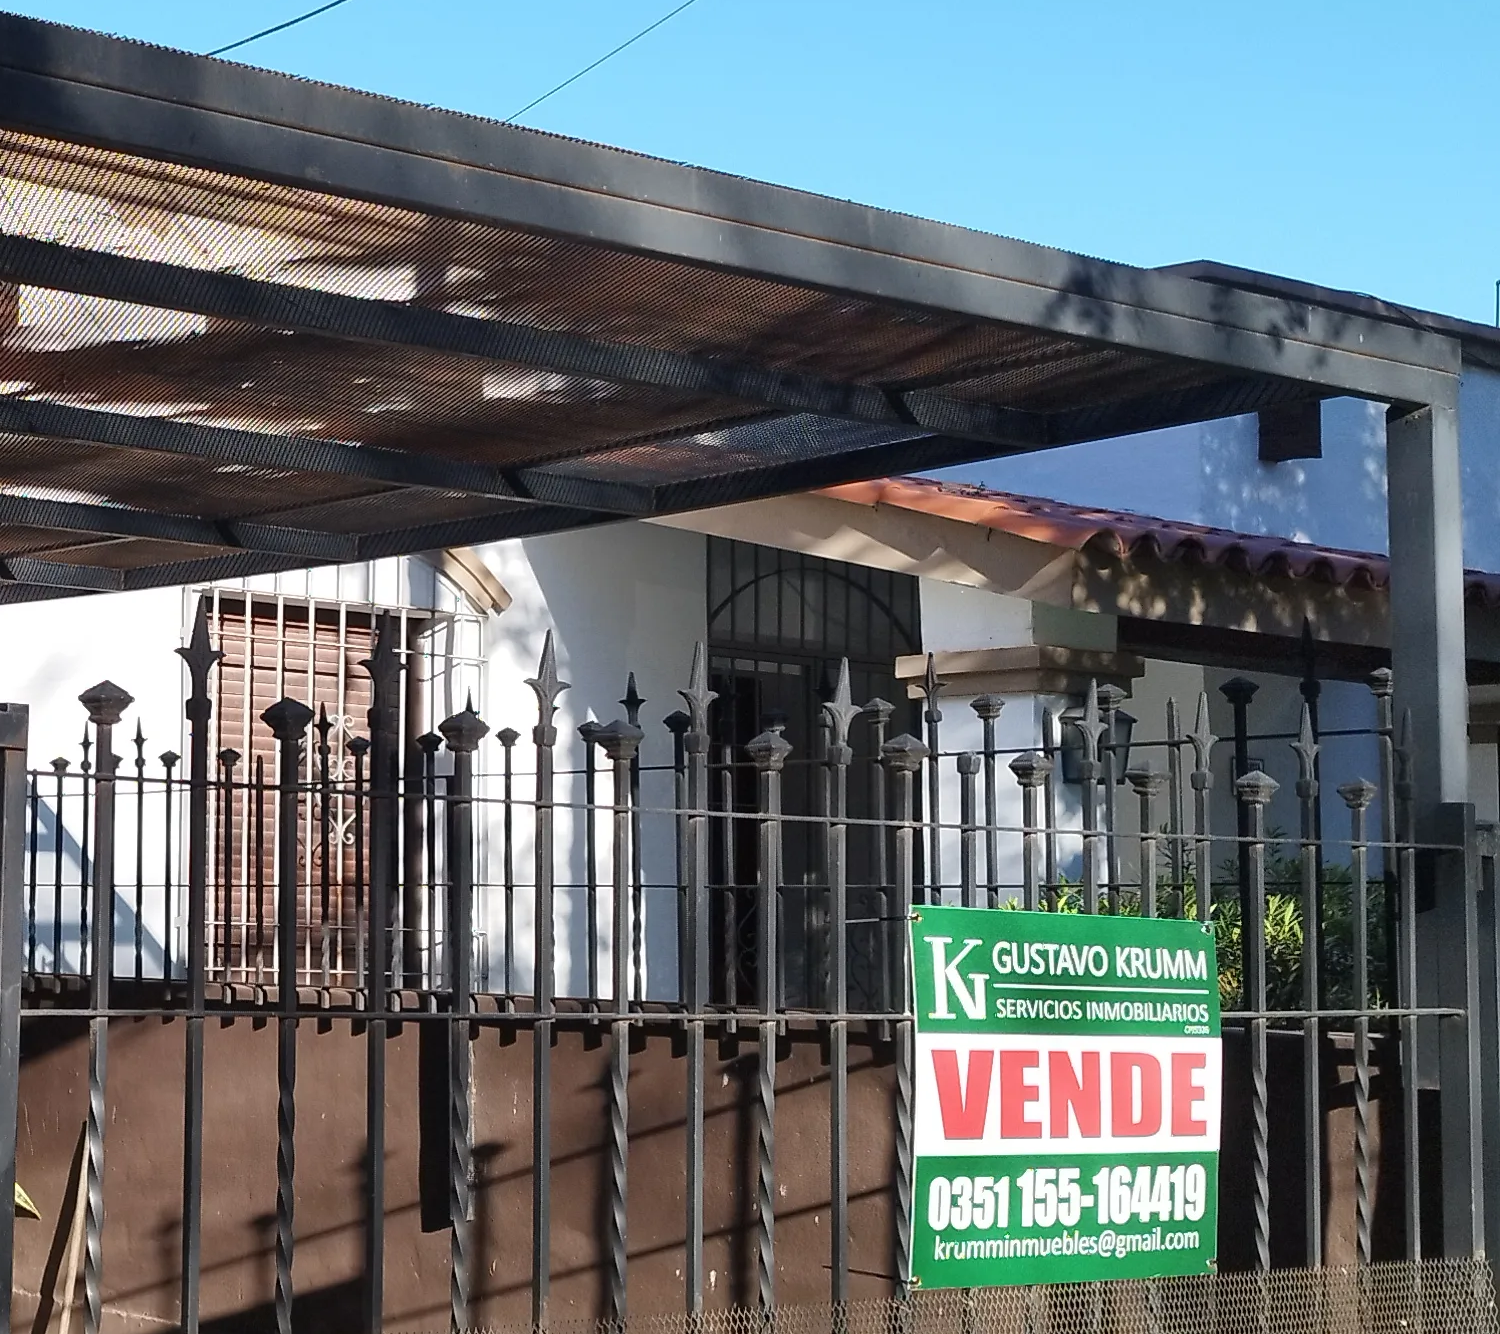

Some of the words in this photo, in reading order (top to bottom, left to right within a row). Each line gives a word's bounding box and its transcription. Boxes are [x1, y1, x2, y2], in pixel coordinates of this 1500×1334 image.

[992, 940, 1109, 977] GUSTAVO
[1115, 946, 1208, 981] KRUMM
[996, 997, 1082, 1020] SERVICIOS
[1086, 1001, 1209, 1023] INMOBILIARIOS
[931, 1049, 1208, 1140] VENDE
[928, 1176, 1009, 1230] 0351
[1016, 1163, 1207, 1228] 155-164419
[934, 1227, 1200, 1261] krumminmuebles@gmail.com
